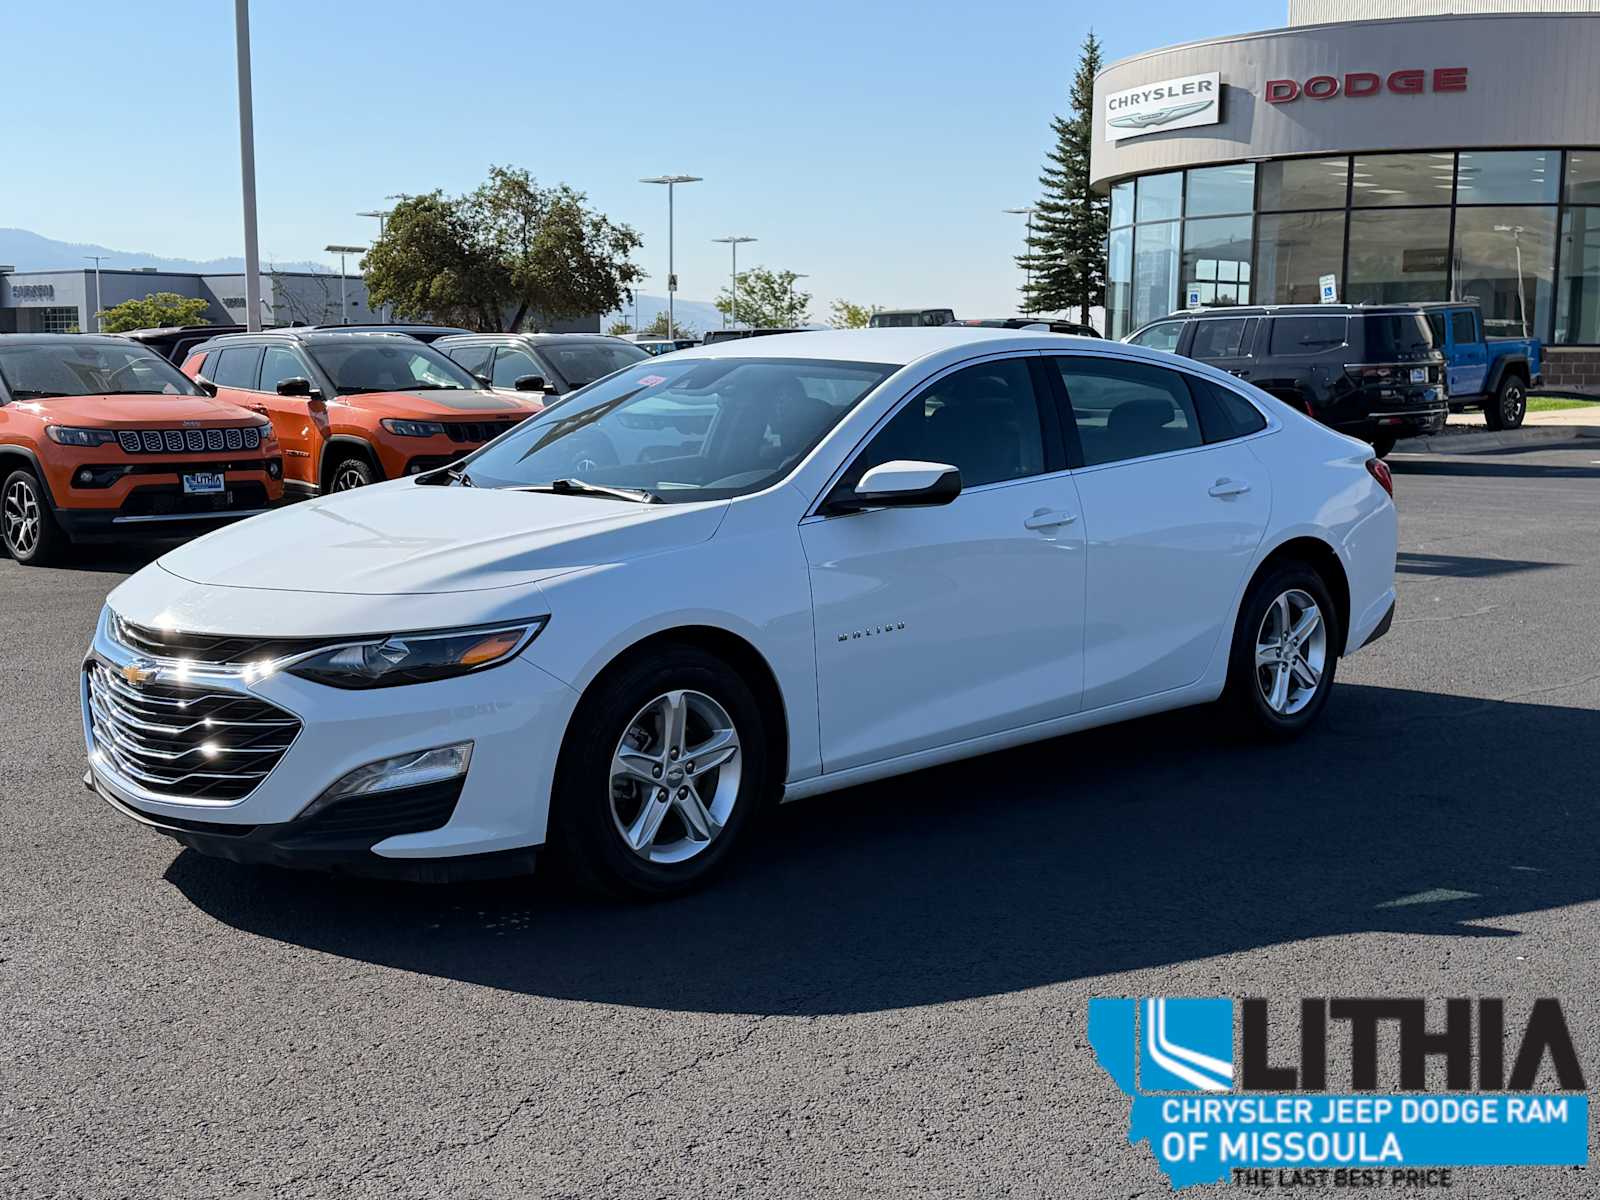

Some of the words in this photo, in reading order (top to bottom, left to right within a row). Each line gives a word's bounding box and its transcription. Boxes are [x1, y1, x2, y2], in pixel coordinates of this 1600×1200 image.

[1108, 80, 1213, 110] CHRYSLER
[1265, 67, 1468, 103] DODGE
[837, 621, 905, 642] MALIBU
